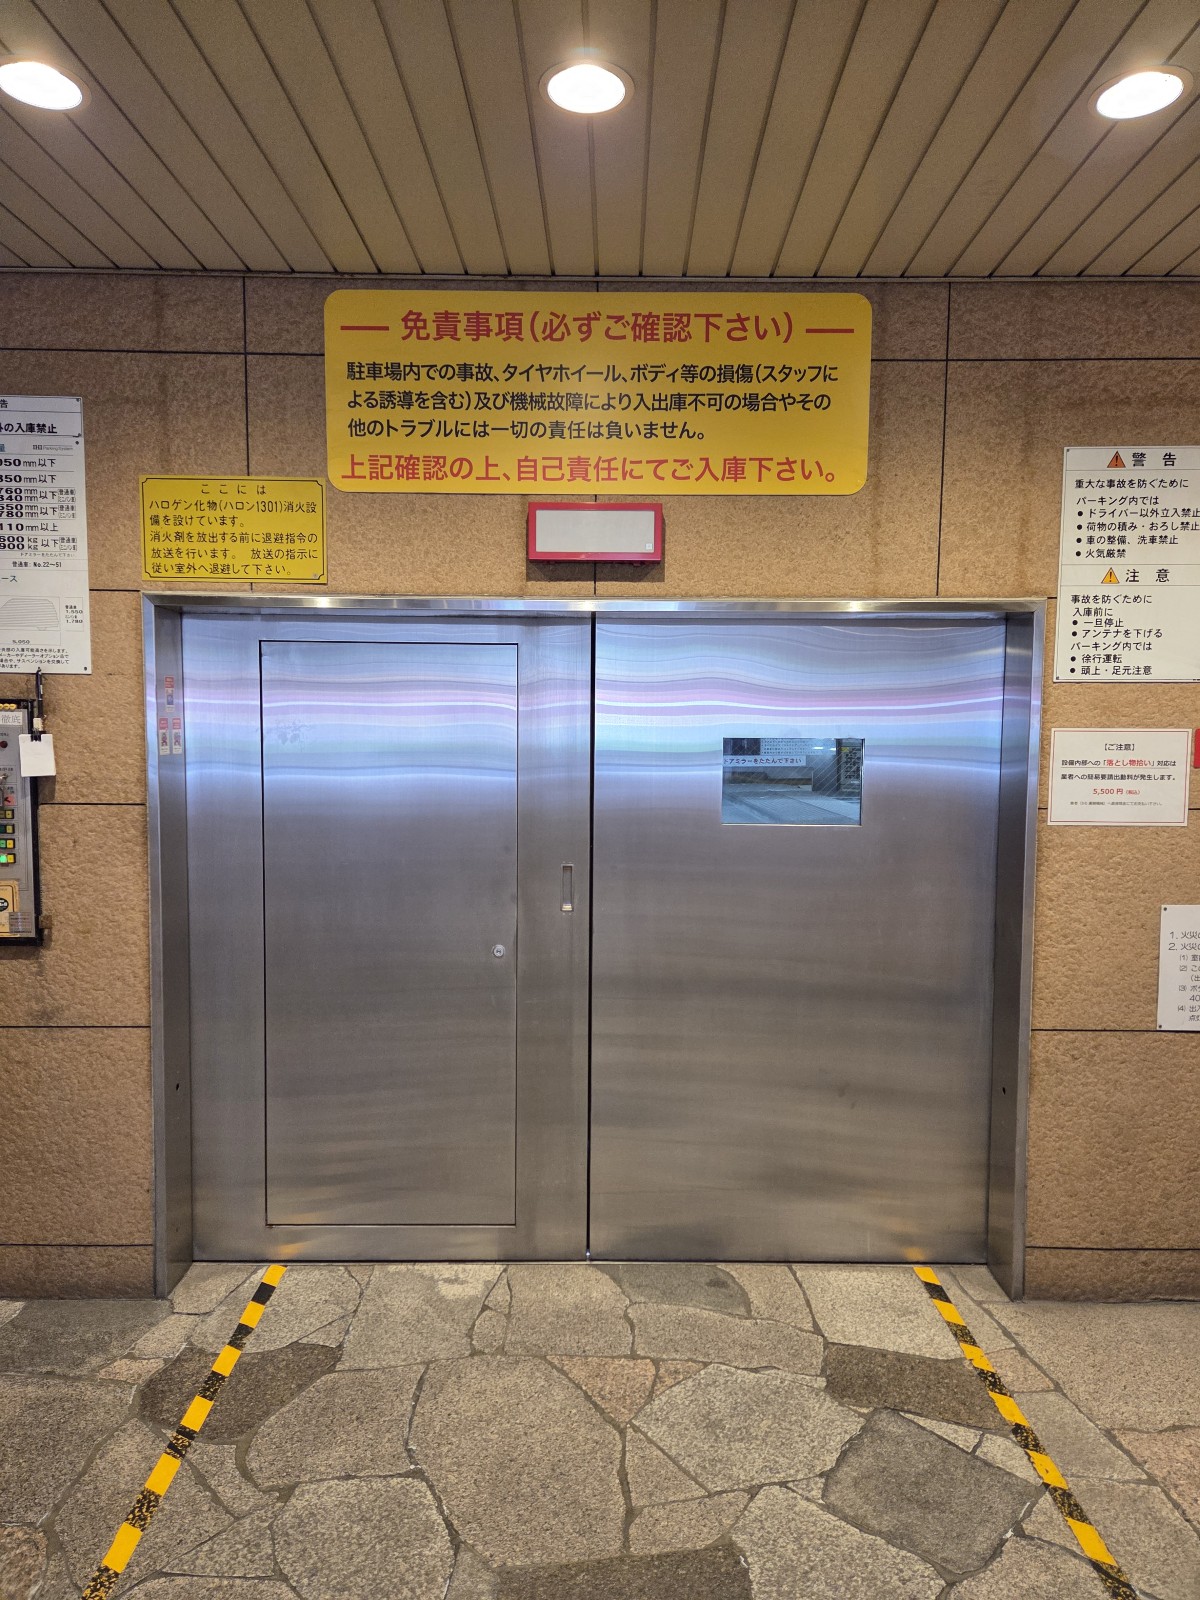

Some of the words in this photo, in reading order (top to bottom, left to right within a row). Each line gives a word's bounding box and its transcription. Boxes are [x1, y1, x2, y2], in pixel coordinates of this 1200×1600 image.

[401, 309, 793, 343] 免責事項(必ずご確認下さい)
[347, 361, 838, 383] 駐車場内での事故、タイヤホイール、ボディ等の損傷(スタッフに
[347, 391, 831, 412] よる誘導を含む)及び機械故障により入出庫不可の場合やその
[348, 418, 704, 440] 他のトラブルには一切の責任は負いません。
[38, 458, 56, 467] 以下
[1132, 452, 1177, 467] 警告
[341, 454, 835, 483] 上記確認の上、自己責任にてご入庫下さい。
[38, 474, 57, 484] 以下
[1075, 478, 1189, 489] 重大な事故を防ぐために
[39, 490, 57, 499] 以下
[201, 483, 266, 495] ここには
[40, 506, 58, 515] 以下
[149, 499, 317, 513] ハロゲン化物(ハロン1301)消火設
[1088, 507, 1200, 518] ドライバー以外立入禁止
[149, 514, 244, 527] 備を設けています。
[40, 522, 59, 532] 以上
[28, 536, 38, 544] kg
[41, 538, 59, 548] 以下
[149, 530, 318, 544] 消火剤を放出する前に退避指令の
[1086, 534, 1179, 545] 車の整備、洗車禁止
[28, 543, 38, 551] kg
[151, 547, 236, 560] 放送を行います。
[251, 547, 318, 560] 放送の指示に
[1085, 548, 1126, 559] 火気厳禁
[151, 562, 291, 576] 従い室外へ退避して下さい。
[1125, 568, 1170, 583] 注意
[1070, 594, 1153, 604] 事故を防ぐために
[1072, 607, 1114, 617] 入庫前に
[1083, 618, 1125, 628] 一旦停止
[1082, 628, 1163, 639] アンテナを下げる
[1081, 653, 1122, 664] 徐行運転
[1080, 665, 1153, 676] 頭上・足元注意
[1093, 788, 1115, 796] 5,500
